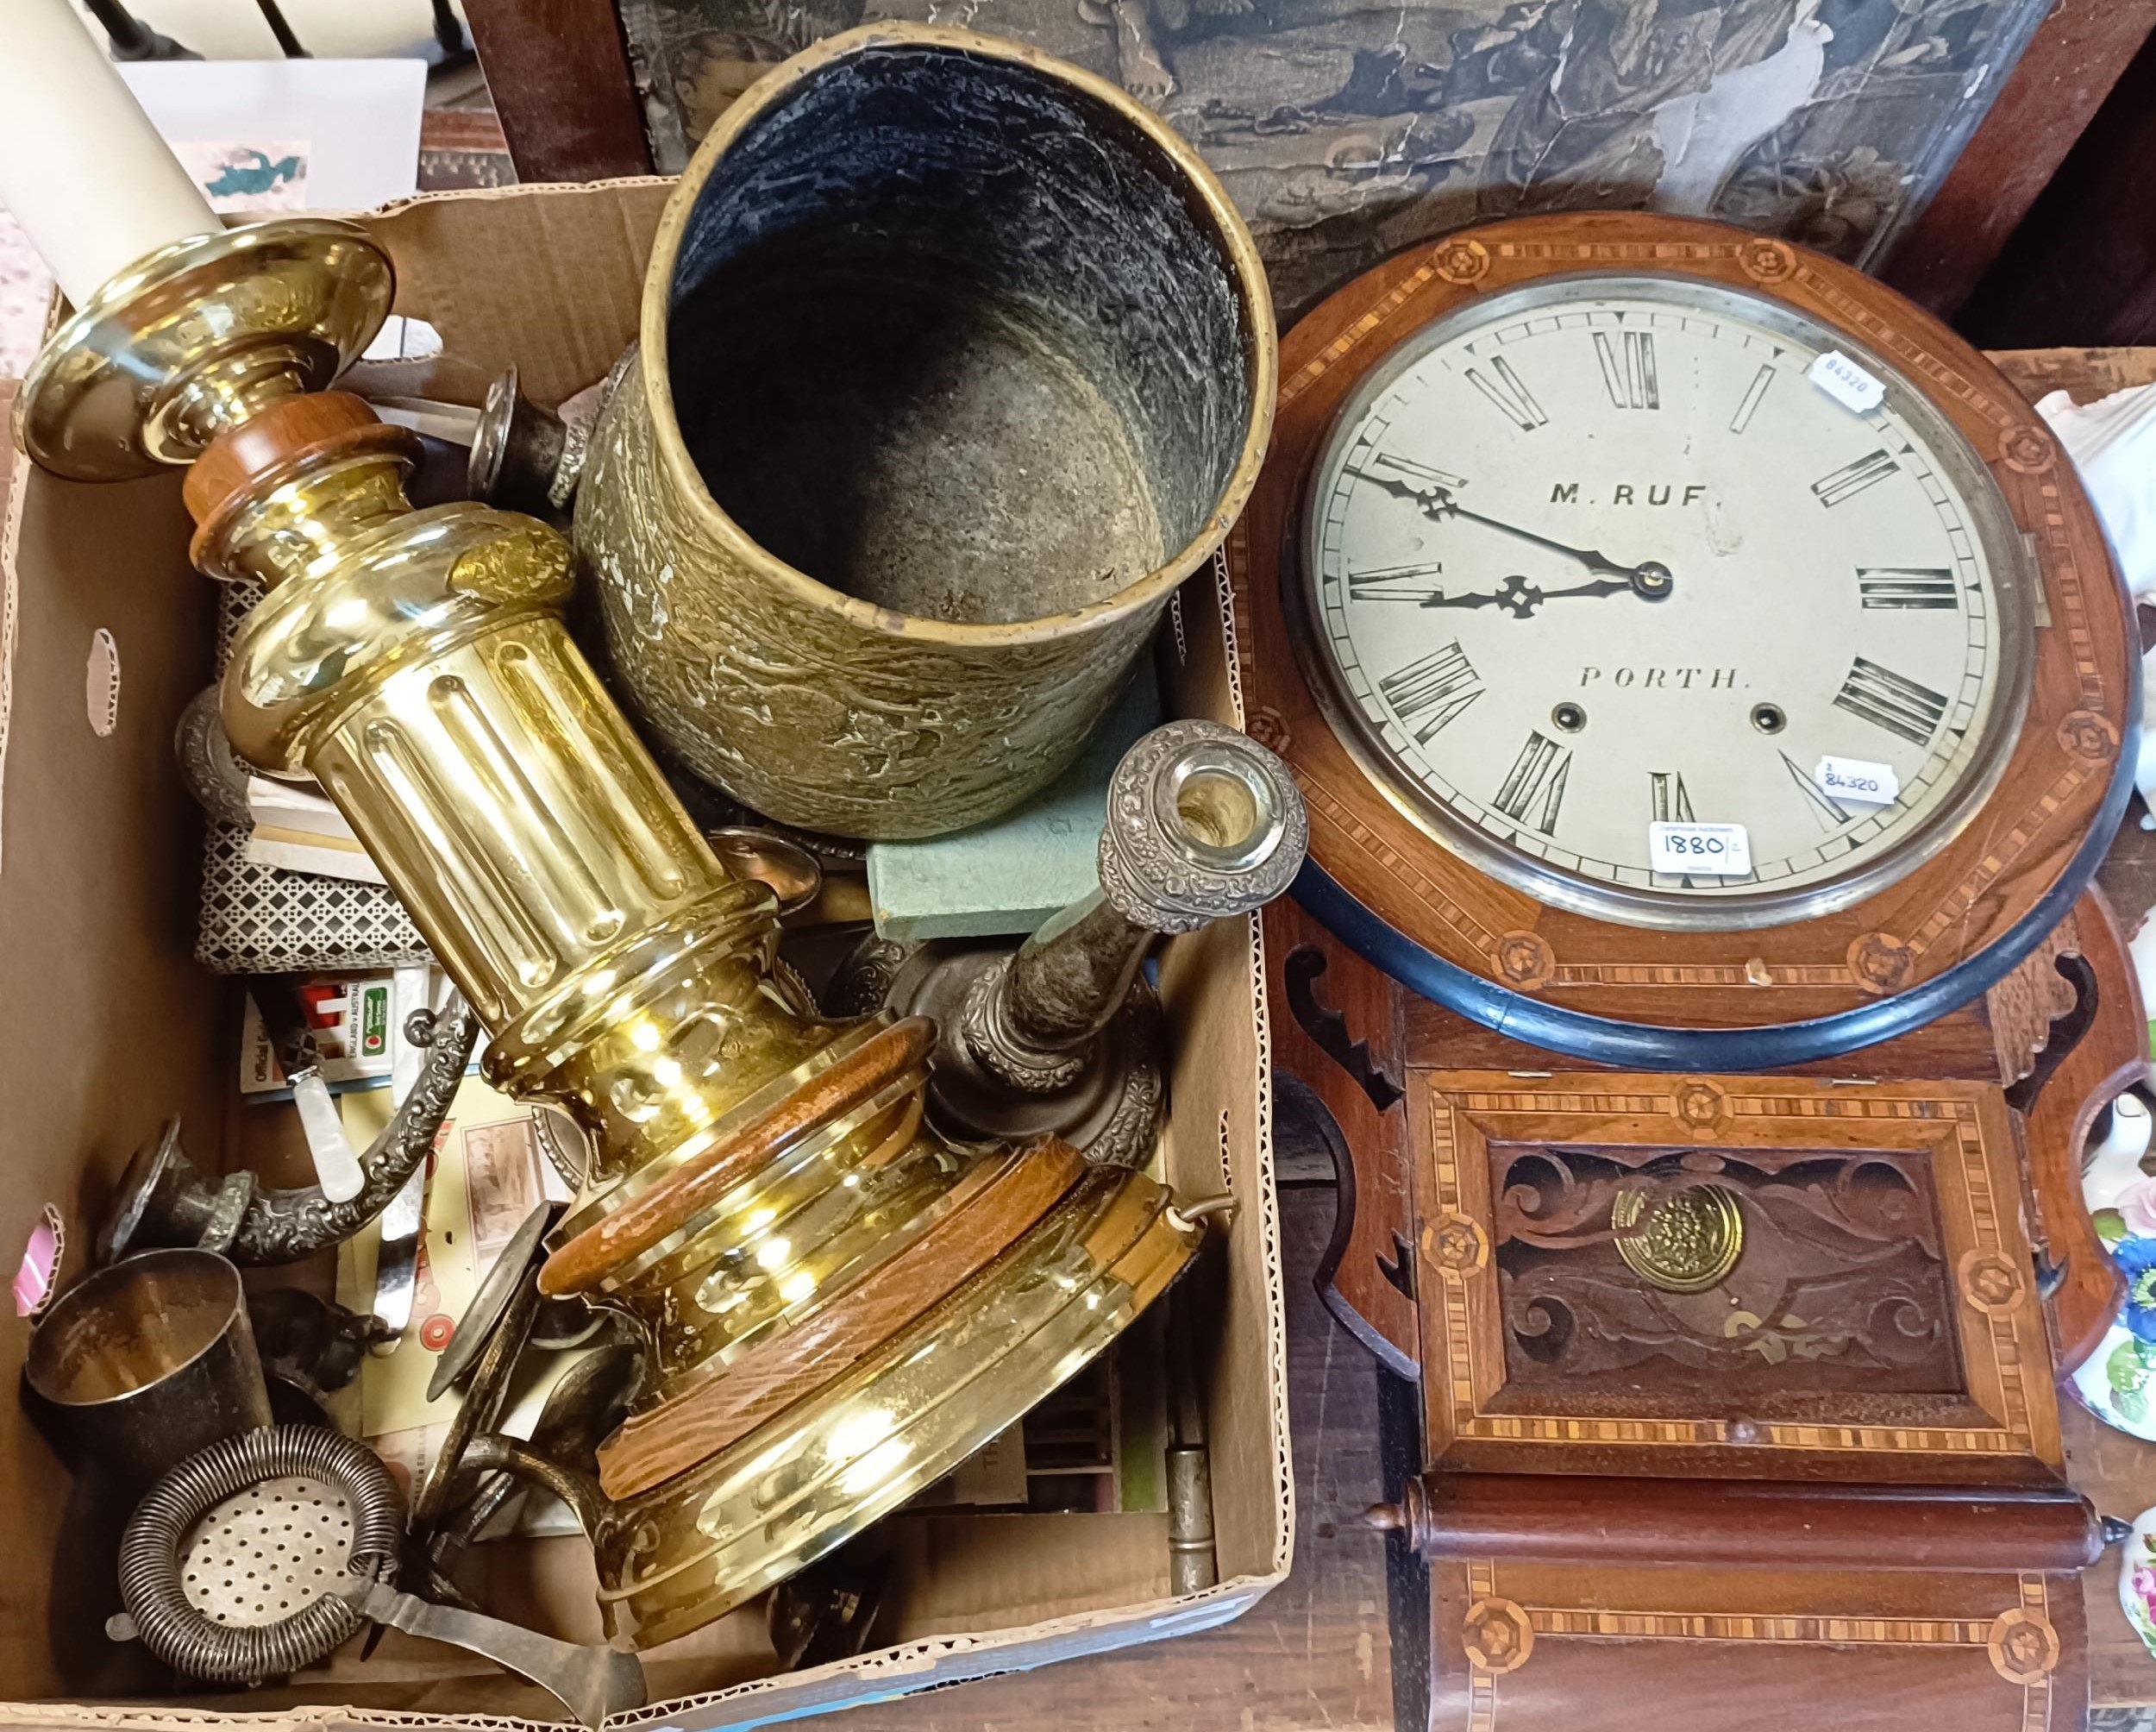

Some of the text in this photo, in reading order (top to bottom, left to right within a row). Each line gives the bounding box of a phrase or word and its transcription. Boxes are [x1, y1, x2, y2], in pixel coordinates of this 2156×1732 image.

[1826, 359, 1868, 392] 84320
[1550, 483, 1595, 505] M.
[1579, 667, 1751, 689] PORTH.
[1825, 773, 1878, 792] 84320
